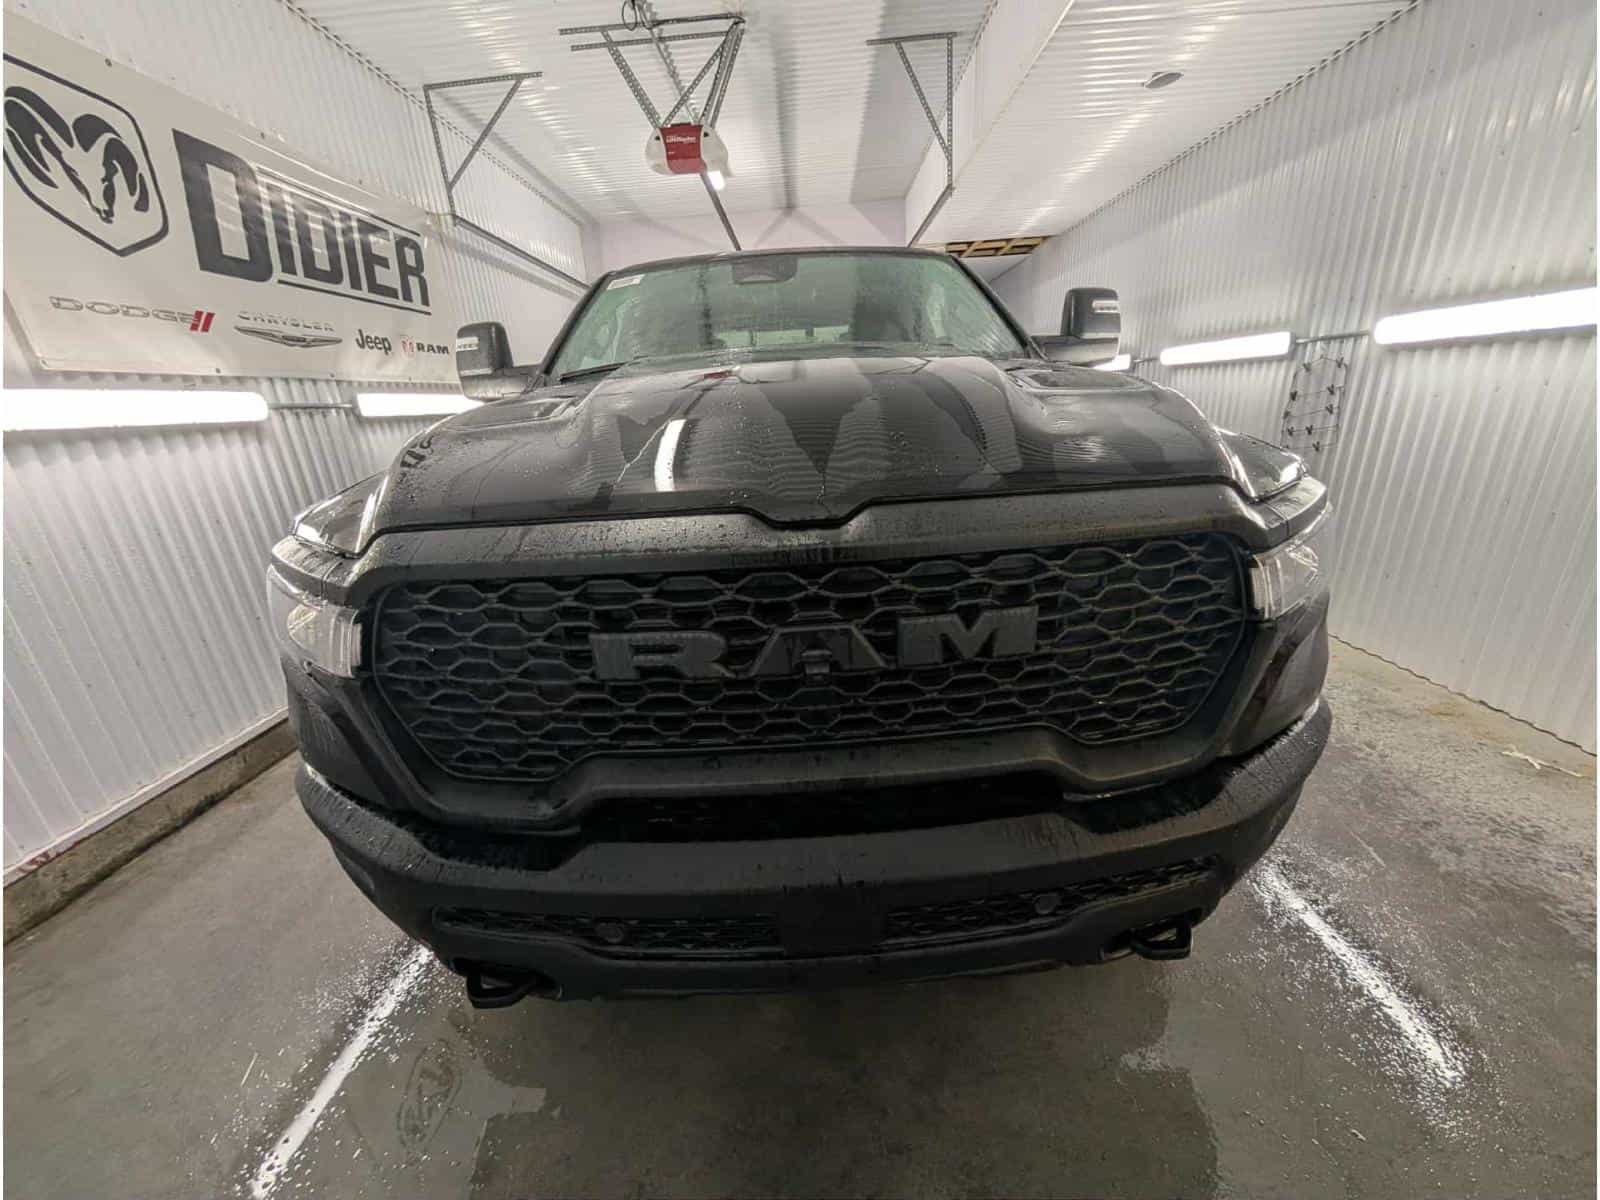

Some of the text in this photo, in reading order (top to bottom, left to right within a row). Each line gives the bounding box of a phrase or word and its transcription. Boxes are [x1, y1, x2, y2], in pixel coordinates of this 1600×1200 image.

[172, 128, 430, 307] DIDIER
[49, 296, 197, 324] DODGE
[355, 328, 392, 356] Jeep
[416, 342, 449, 355] RAM
[589, 606, 1038, 679] RAM
